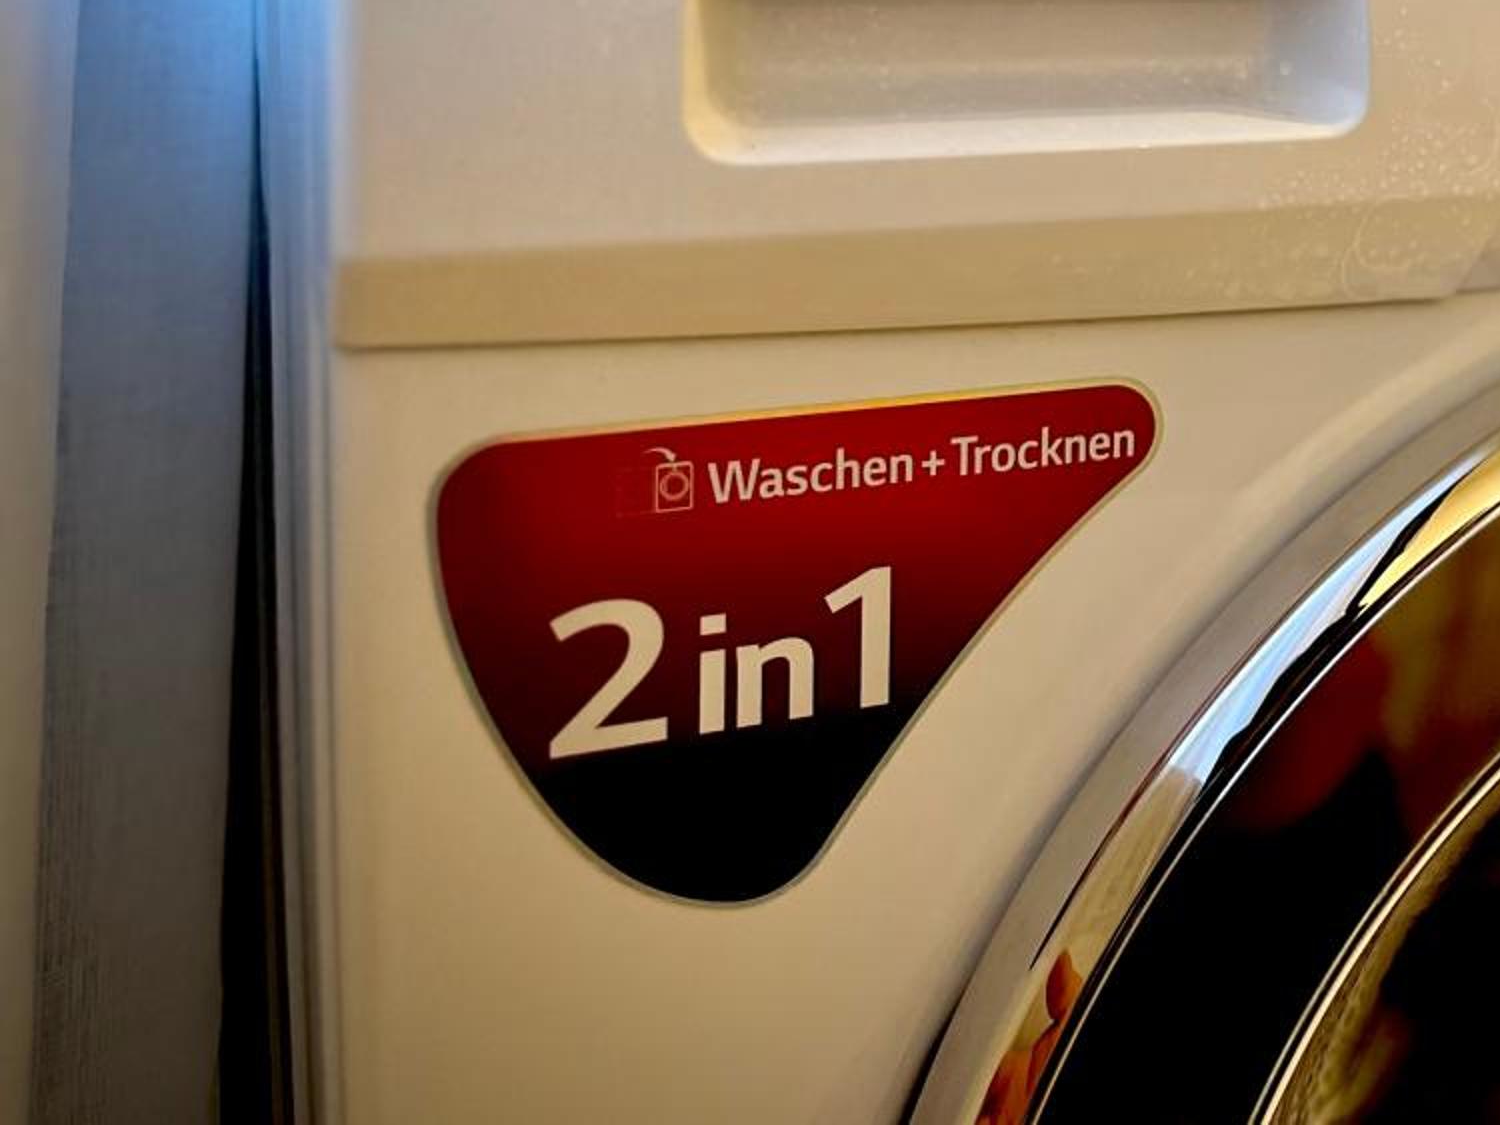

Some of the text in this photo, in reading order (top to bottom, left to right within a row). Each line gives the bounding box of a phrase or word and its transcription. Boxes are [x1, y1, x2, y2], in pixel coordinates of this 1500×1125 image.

[549, 565, 891, 760] 2 in 1
